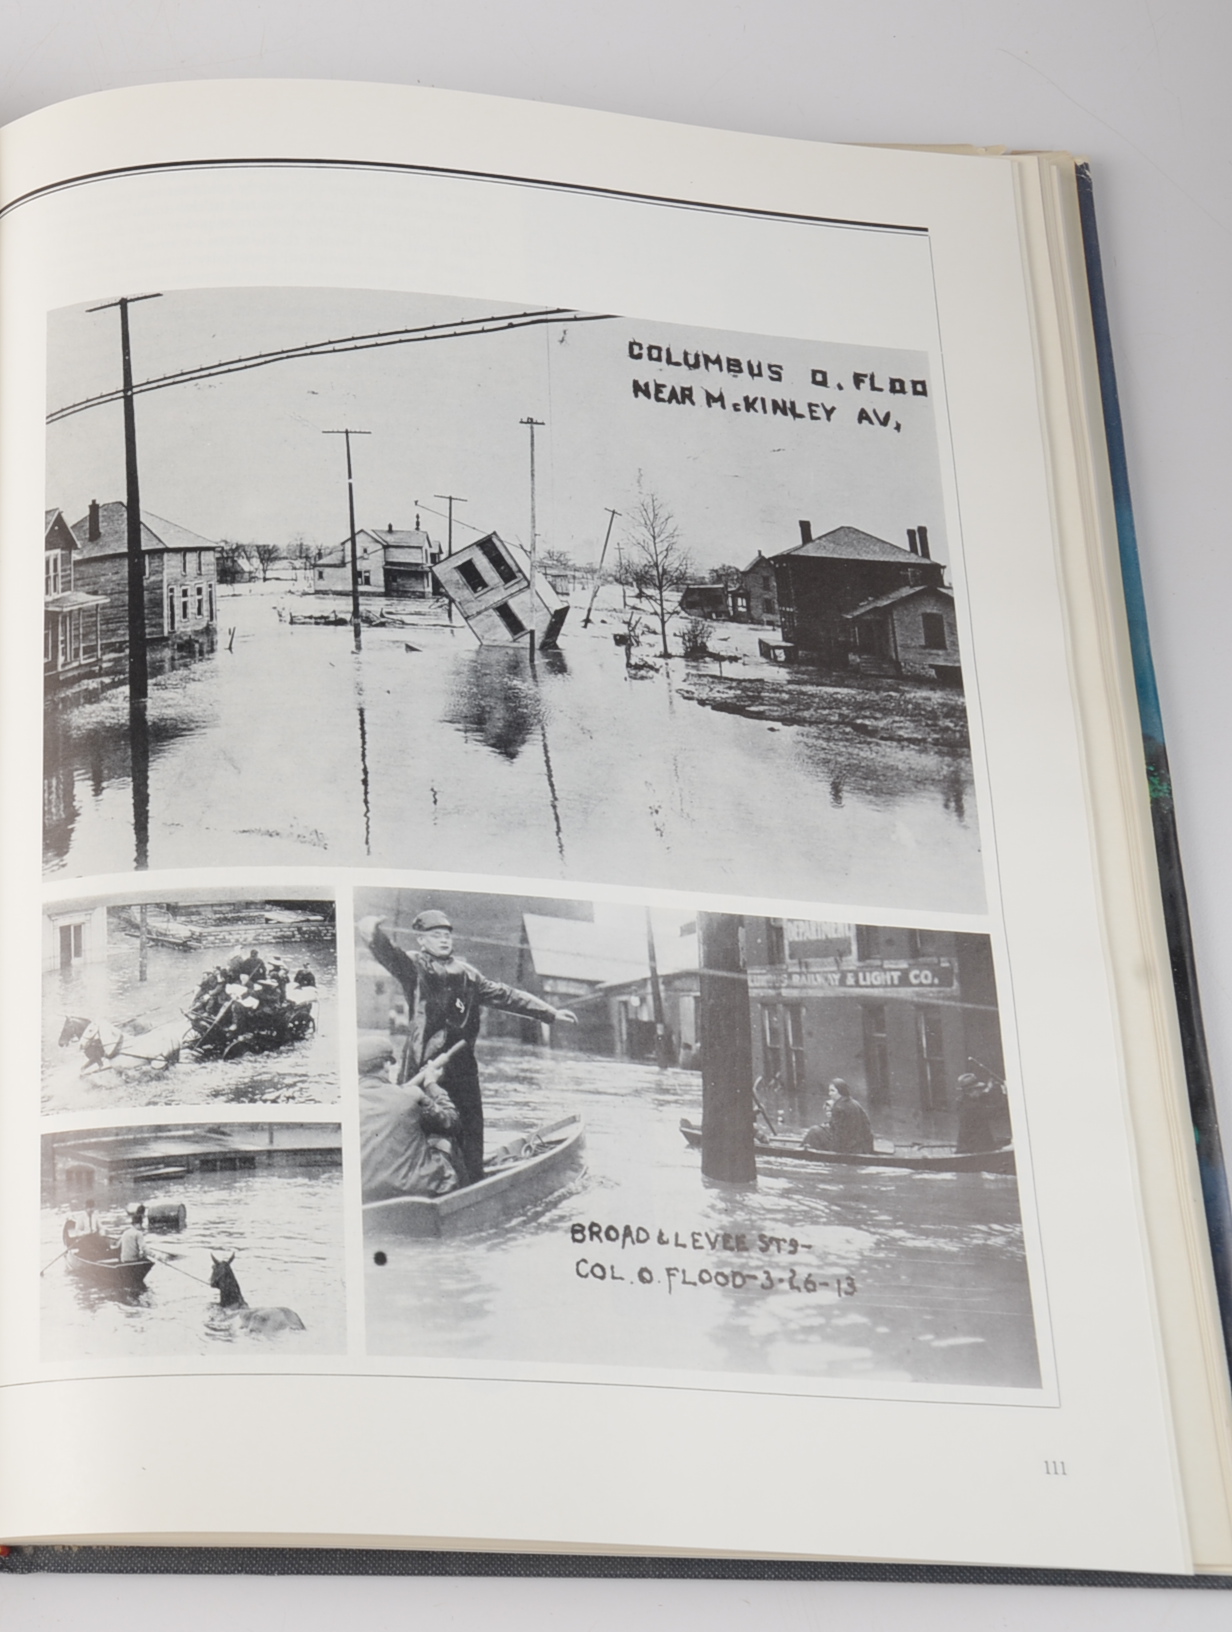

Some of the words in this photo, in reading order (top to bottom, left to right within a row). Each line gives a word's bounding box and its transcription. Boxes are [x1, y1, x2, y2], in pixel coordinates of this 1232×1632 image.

[628, 338, 783, 382] COLUMBUS
[811, 369, 844, 390] O.
[853, 371, 928, 398] FLOO
[632, 379, 696, 406] NEAR
[846, 972, 855, 985] &
[859, 971, 901, 985] LIGHT
[909, 970, 938, 984] CO.
[570, 1221, 650, 1249] BROAD
[657, 1229, 669, 1245] &
[674, 1231, 749, 1252] LEVEE
[1043, 1460, 1067, 1475] 111
